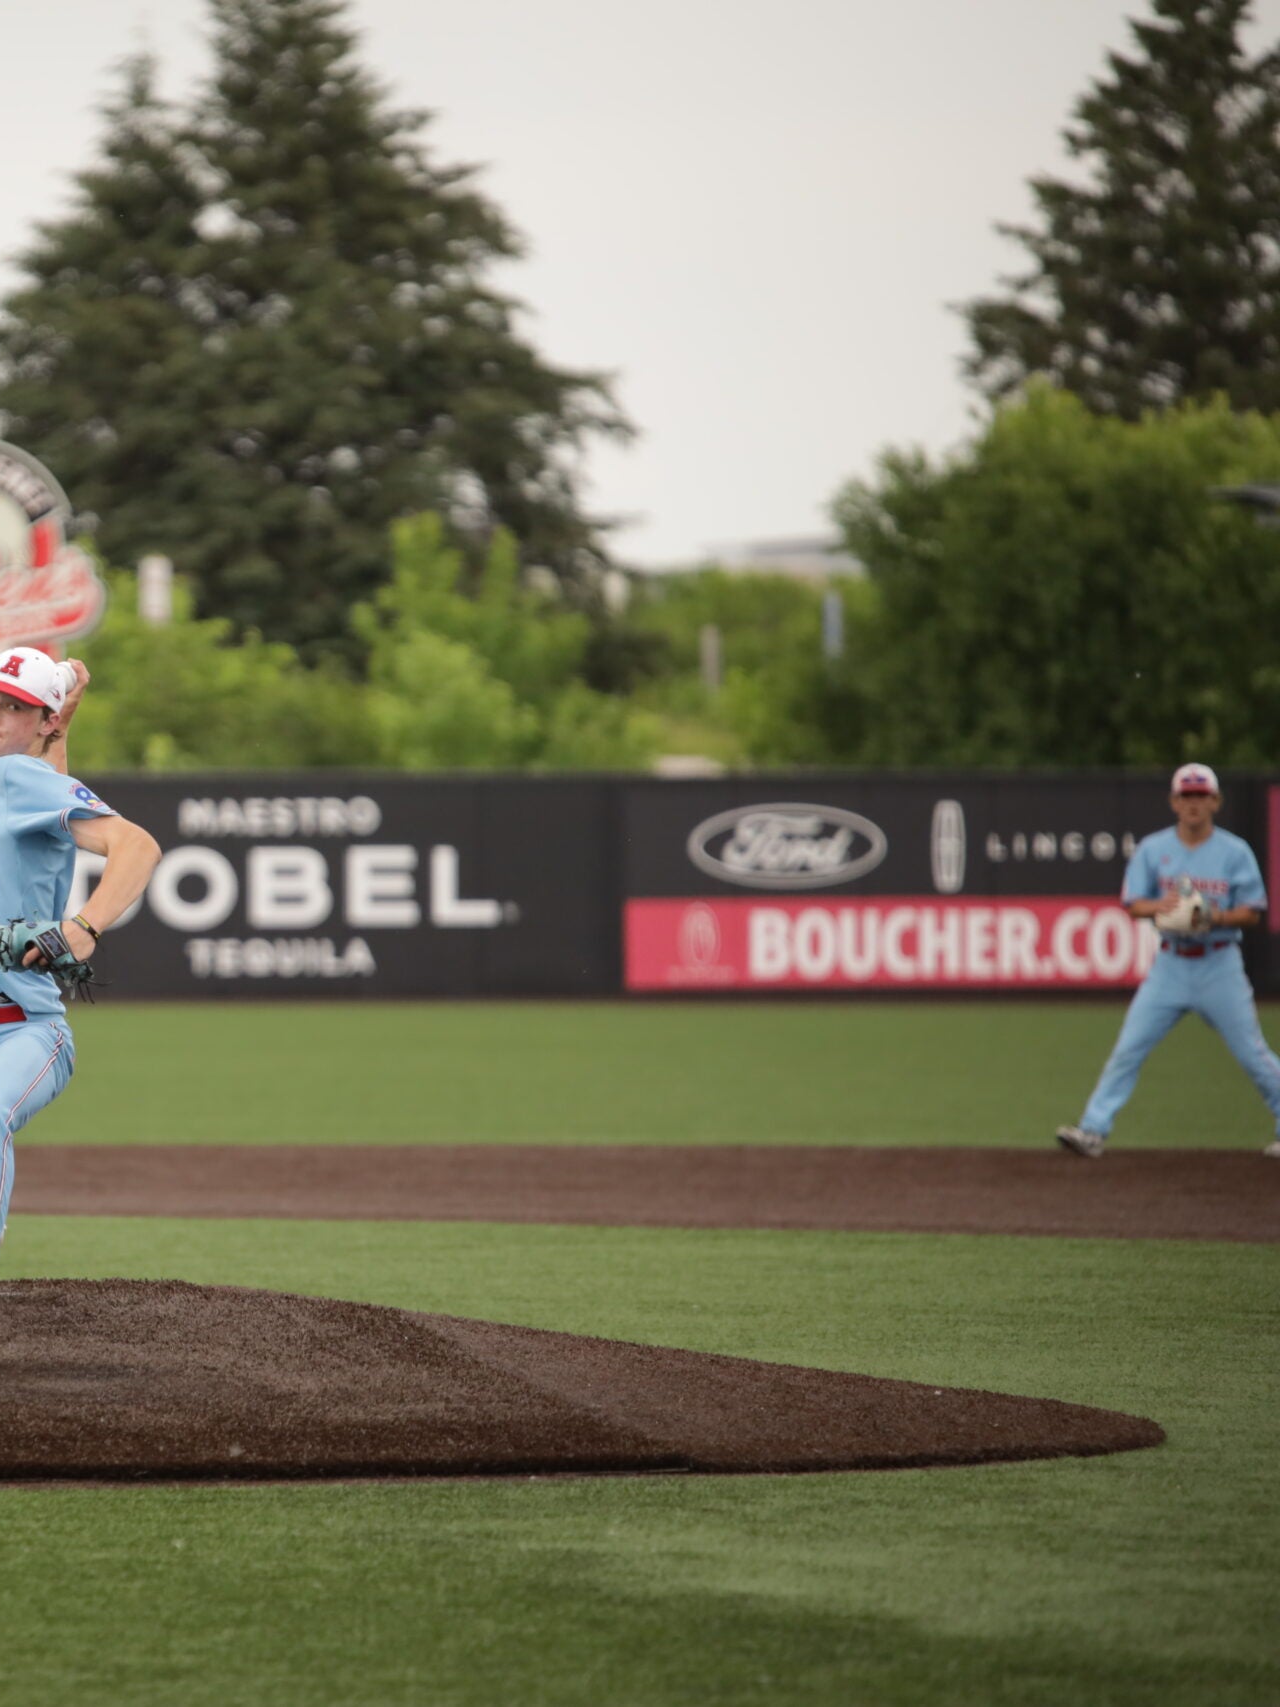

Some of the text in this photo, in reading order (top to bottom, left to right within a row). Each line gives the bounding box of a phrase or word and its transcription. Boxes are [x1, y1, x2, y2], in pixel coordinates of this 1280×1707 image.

[0, 655, 25, 678] A
[178, 797, 382, 836] MAESTRO
[722, 812, 855, 876] Ford
[985, 831, 1137, 862] LINCOL
[186, 937, 376, 977] TEQUILA
